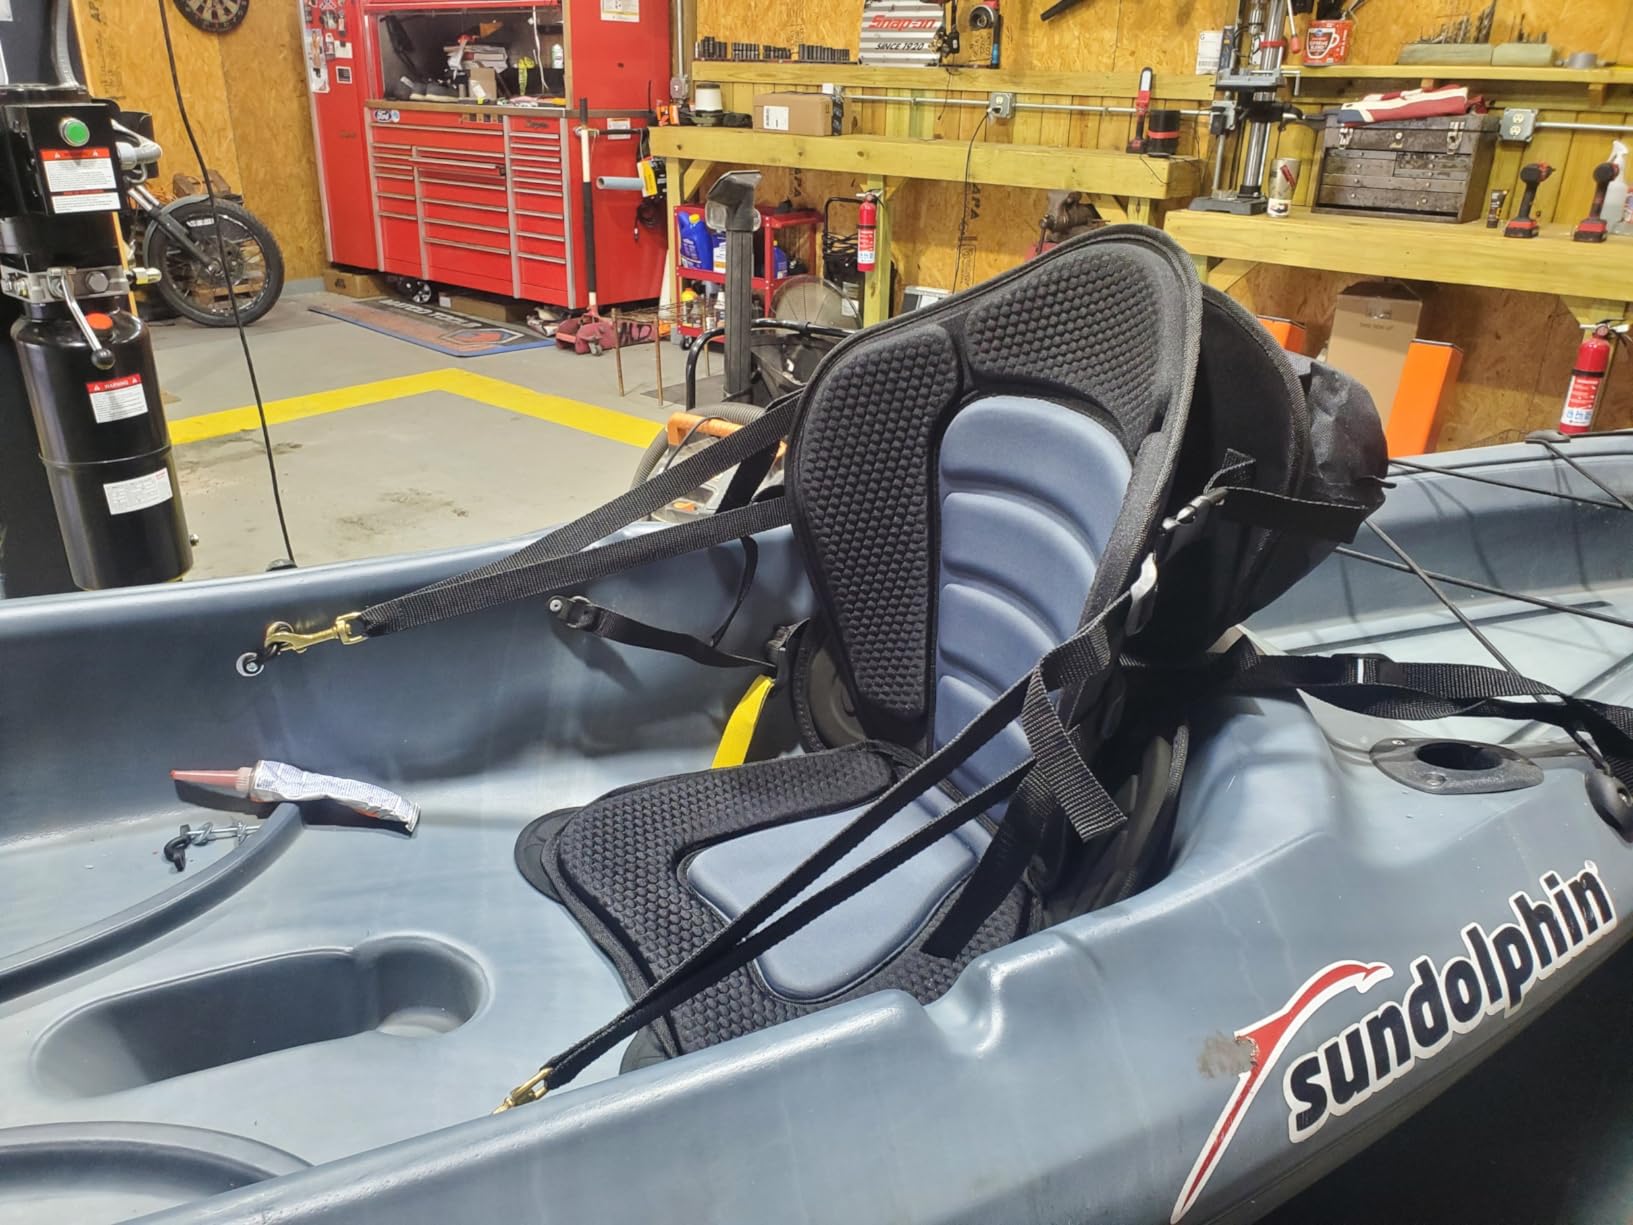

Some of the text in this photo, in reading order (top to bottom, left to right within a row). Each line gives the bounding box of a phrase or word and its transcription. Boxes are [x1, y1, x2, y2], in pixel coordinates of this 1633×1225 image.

[875, 42, 925, 51] SINCE 1920
[1287, 869, 1614, 1134] sundolphin
